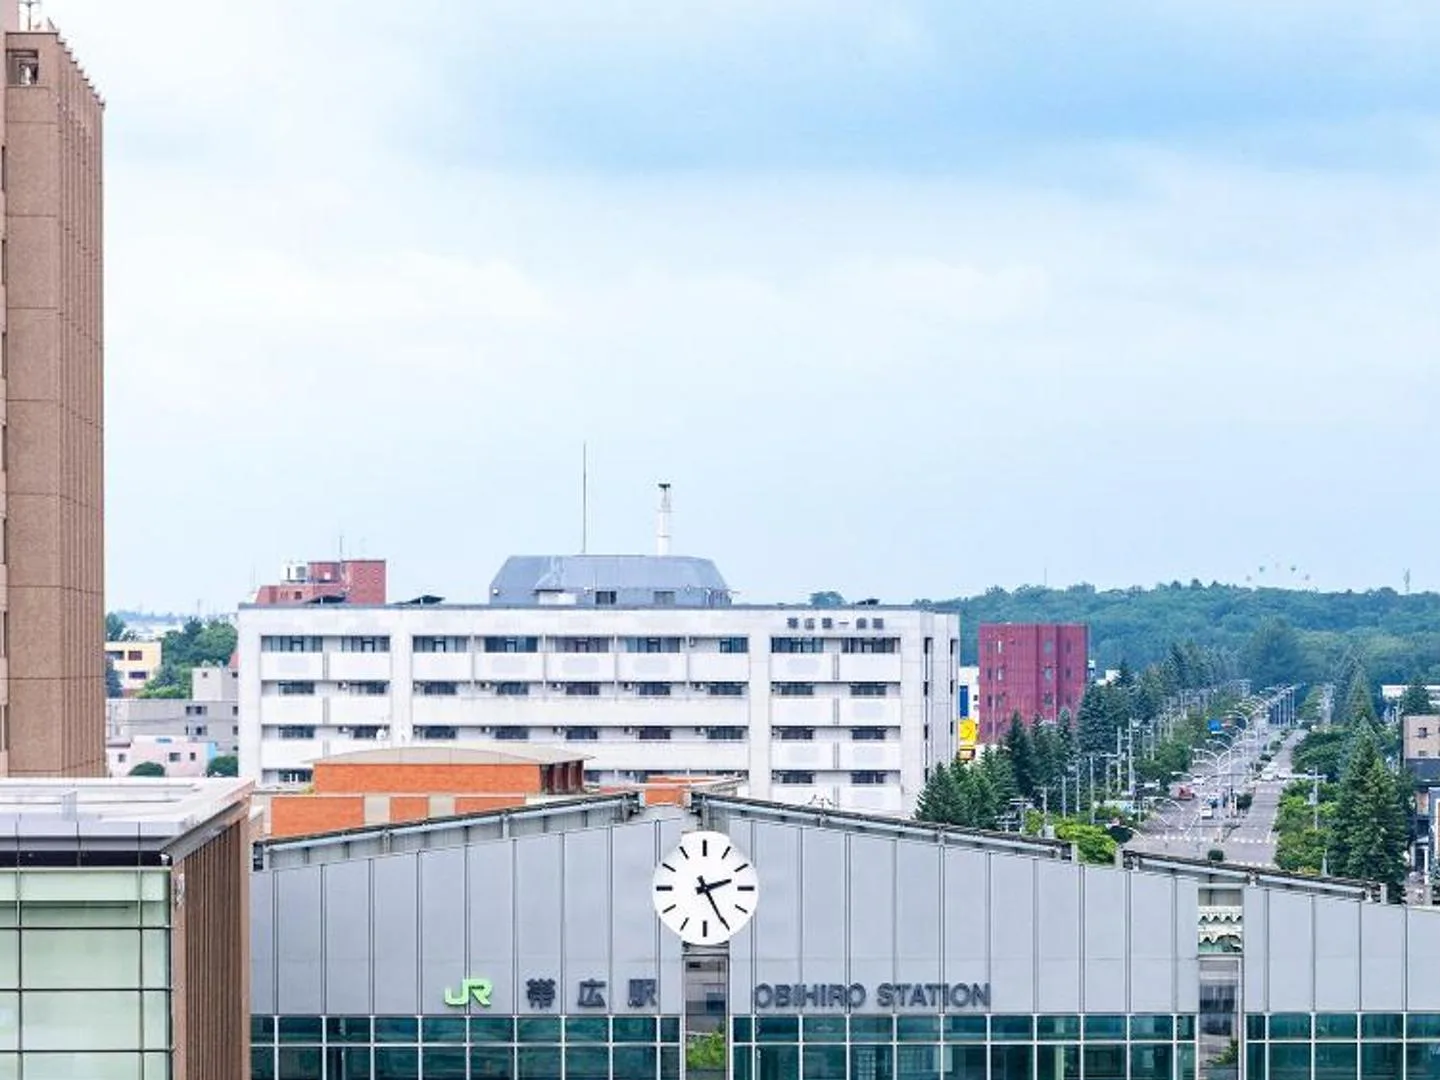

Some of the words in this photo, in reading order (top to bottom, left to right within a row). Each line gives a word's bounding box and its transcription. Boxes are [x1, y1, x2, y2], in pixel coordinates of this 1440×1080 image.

[444, 978, 493, 1007] JR
[526, 978, 657, 1009] 帯広駅
[755, 982, 867, 1008] OBIHIRO
[876, 982, 992, 1007] STATION
